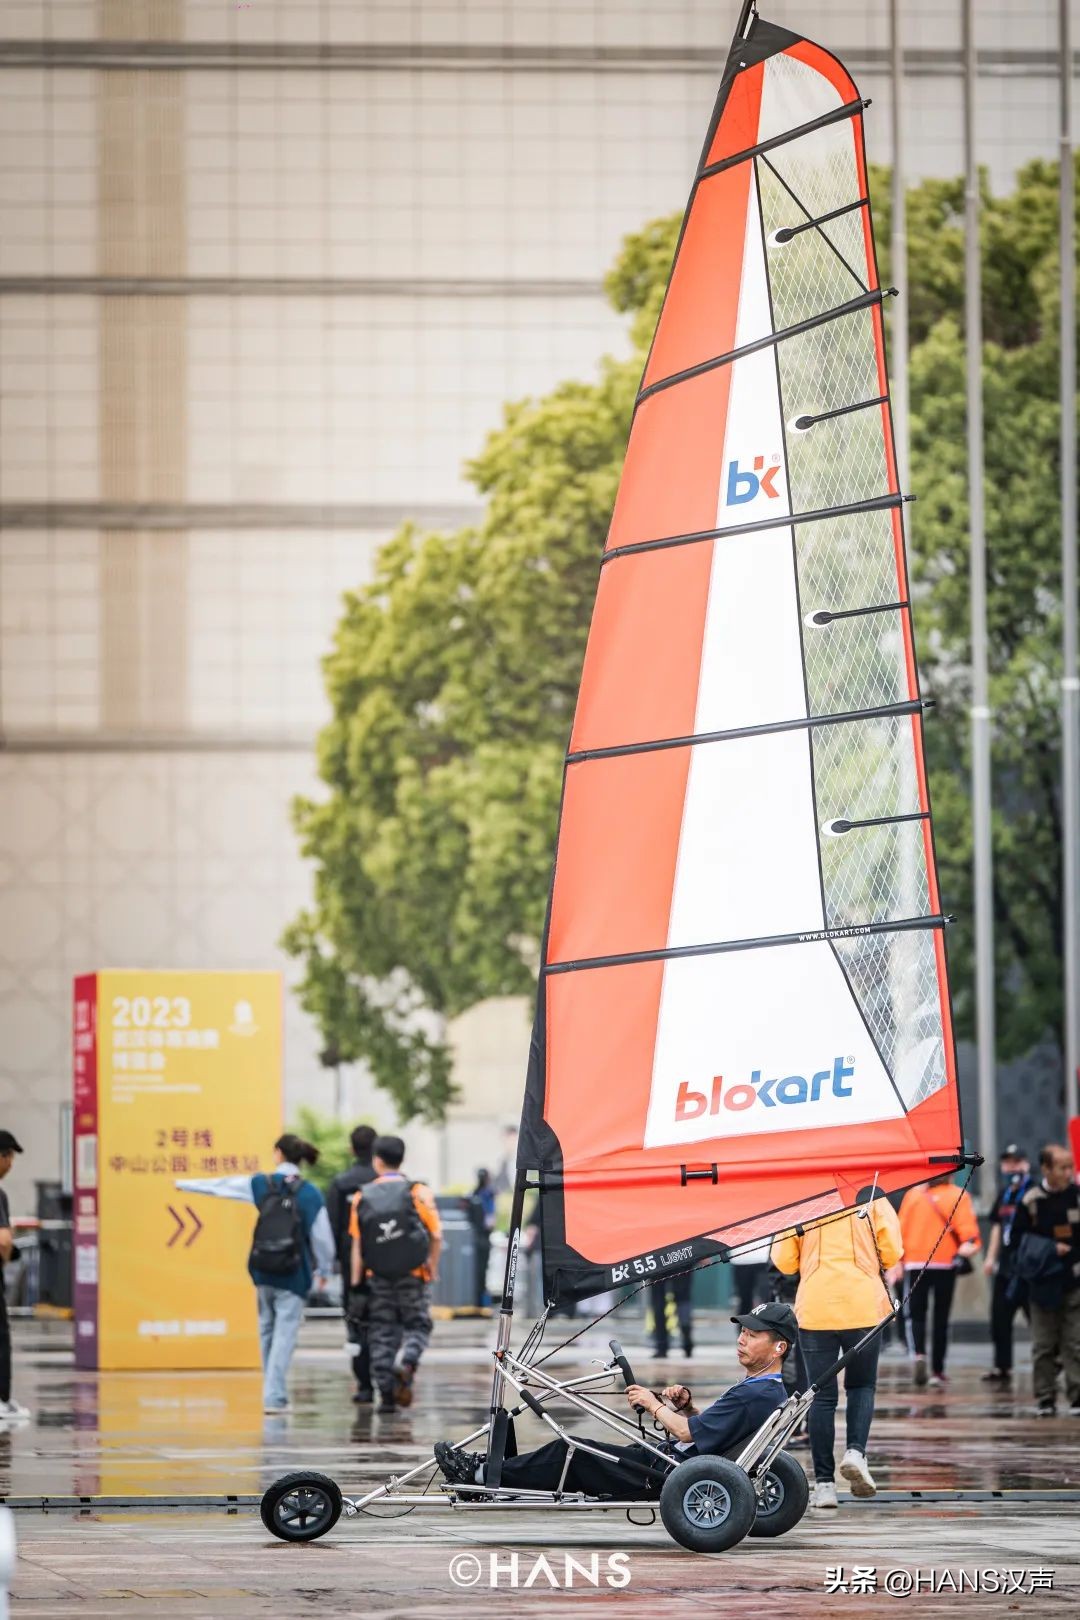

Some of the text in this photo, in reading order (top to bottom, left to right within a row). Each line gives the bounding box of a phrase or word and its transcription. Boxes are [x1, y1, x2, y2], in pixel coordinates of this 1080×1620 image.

[799, 927, 871, 941] WWW.BLOKART.COM
[112, 996, 191, 1027] 2023
[675, 1057, 854, 1122] blokart
[633, 1255, 657, 1274] 5.5
[660, 1245, 693, 1266] LIGHT
